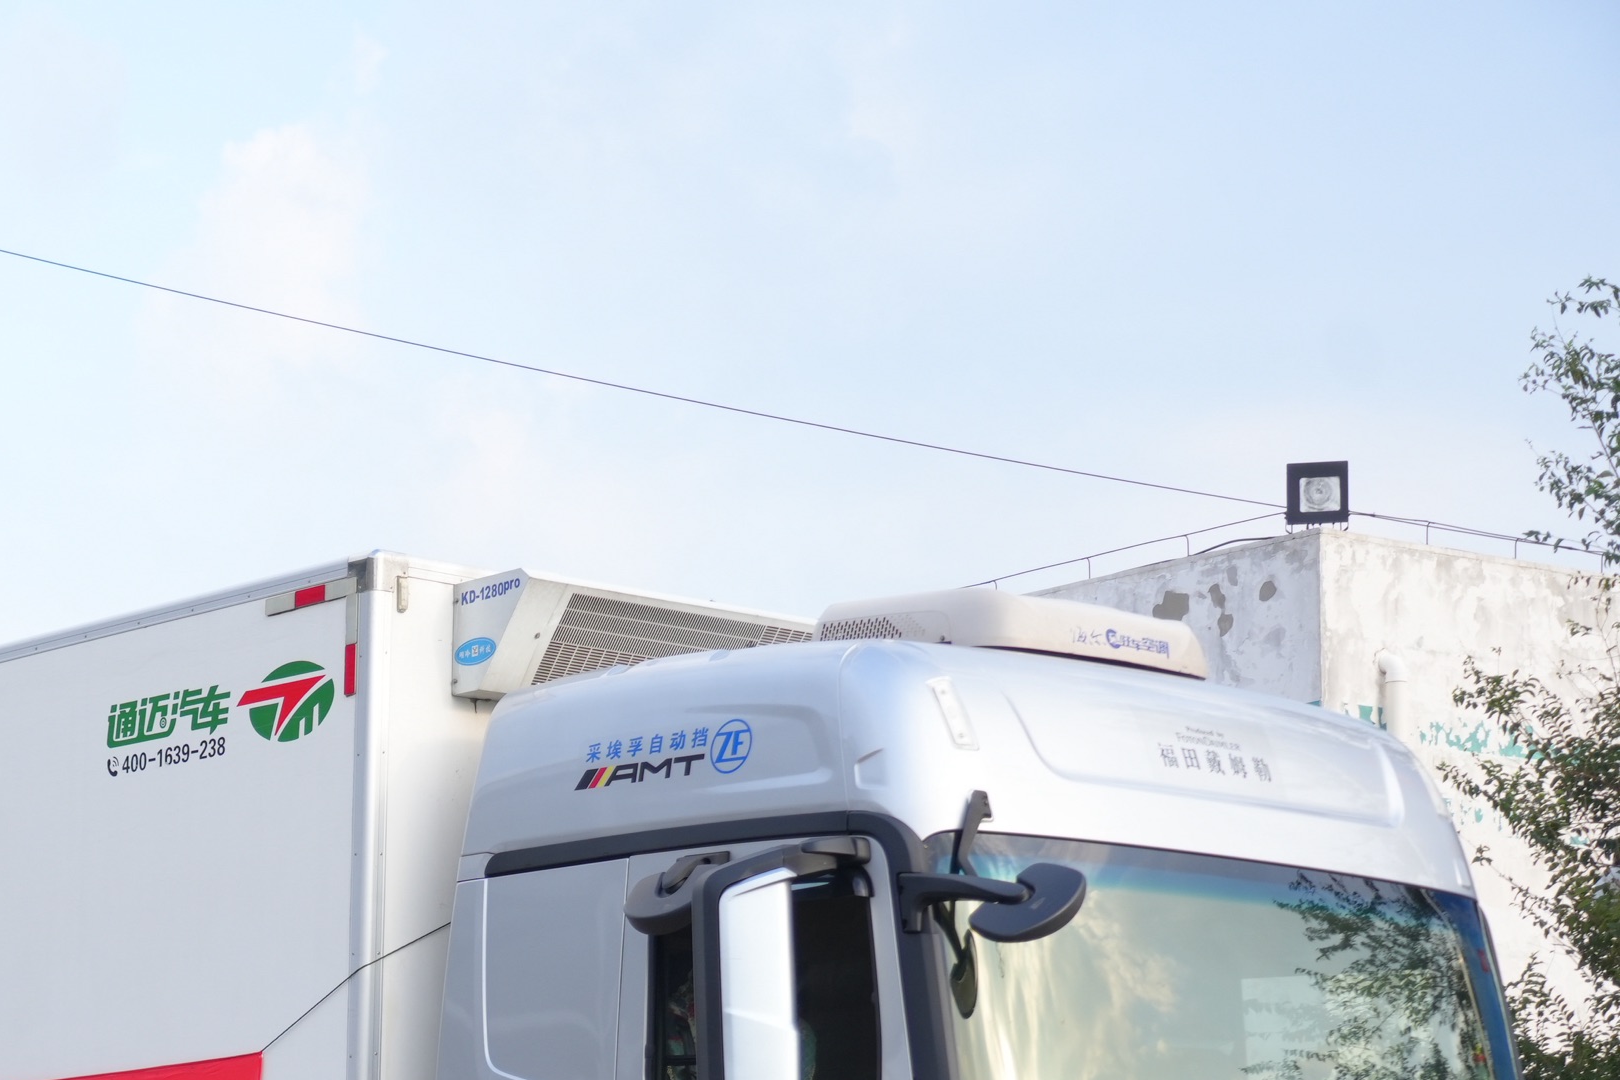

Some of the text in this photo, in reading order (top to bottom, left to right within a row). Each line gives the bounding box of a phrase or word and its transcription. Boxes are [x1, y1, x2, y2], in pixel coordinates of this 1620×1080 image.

[461, 578, 521, 606] KD-1280pro
[107, 684, 231, 748] 通迈汽车
[122, 736, 226, 774] 400-1639-238
[585, 727, 709, 763] 采埃孚自动挡
[603, 753, 705, 788] AMT
